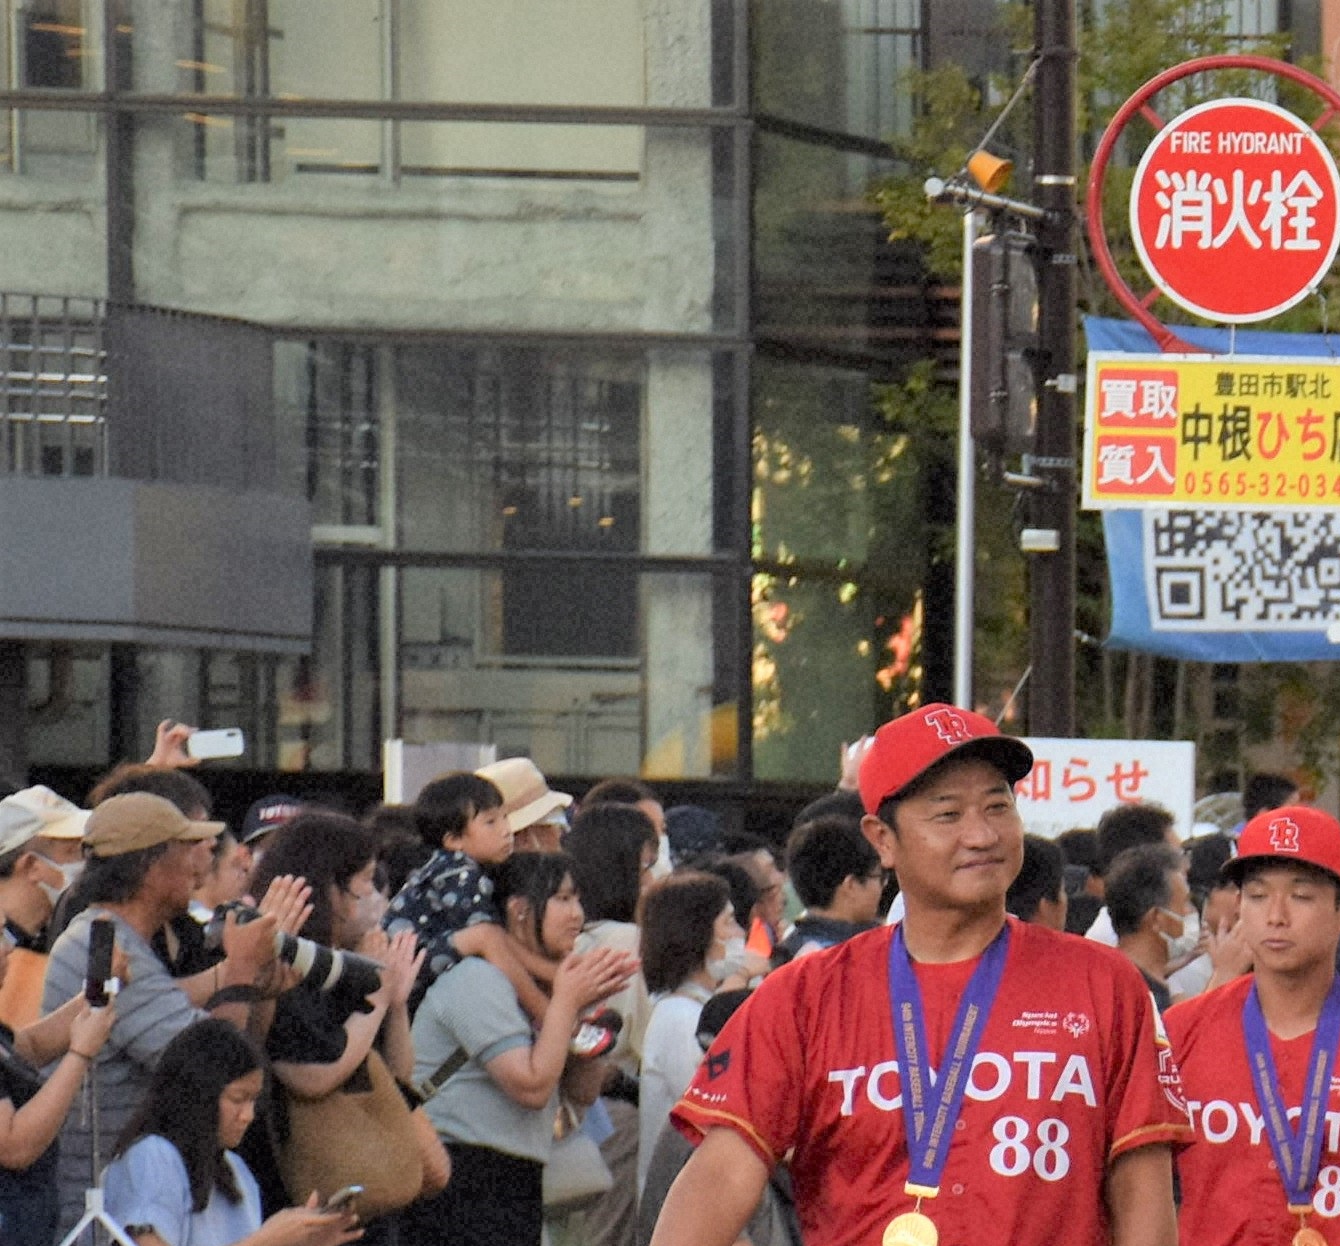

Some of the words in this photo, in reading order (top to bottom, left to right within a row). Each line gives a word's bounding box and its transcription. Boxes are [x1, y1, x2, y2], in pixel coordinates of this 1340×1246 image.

[1170, 131, 1212, 155] FIRE
[1217, 131, 1305, 156] HYDRANT
[1154, 168, 1325, 251] 消火栓
[1100, 378, 1178, 420] 買取
[1214, 371, 1332, 400] 豊田市駅北
[1098, 444, 1176, 486] 質入
[828, 1051, 1097, 1117] TOOTA
[989, 1115, 1070, 1182] 88
